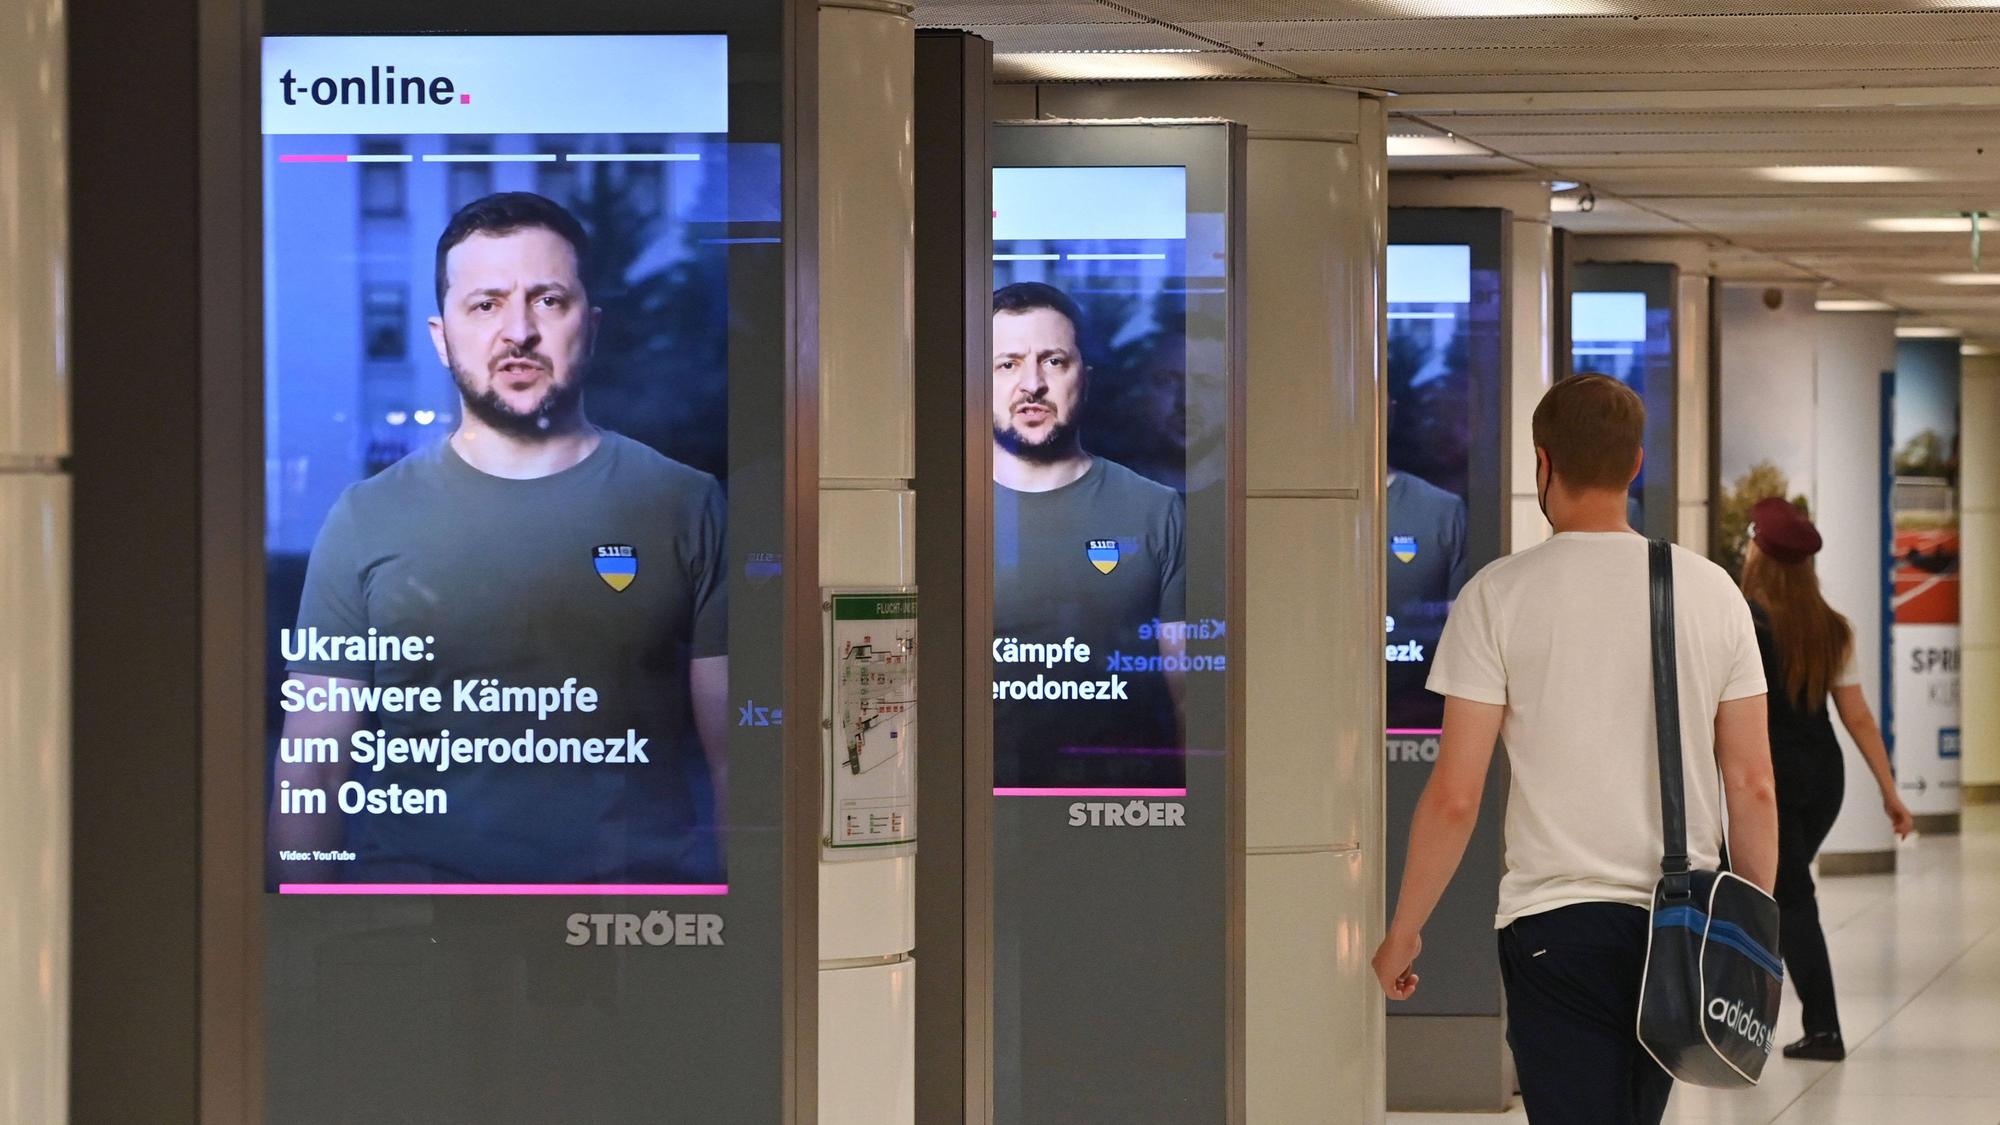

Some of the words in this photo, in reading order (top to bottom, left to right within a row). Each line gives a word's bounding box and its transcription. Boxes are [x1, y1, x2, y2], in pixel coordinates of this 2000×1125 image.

[279, 65, 471, 106] t-online.
[280, 627, 435, 661] Ukraine:
[280, 679, 442, 712] Schwere
[453, 679, 598, 720] Kämpfe
[280, 737, 339, 764] um
[350, 729, 649, 771] Sjewjerodonezk
[280, 780, 326, 814] im
[338, 781, 447, 815] Osten
[1068, 800, 1186, 827] STRÖER
[279, 850, 311, 861] Video:
[312, 850, 356, 861] YouTube
[565, 909, 724, 946] STRÖER
[1708, 997, 1767, 1047] adidas
